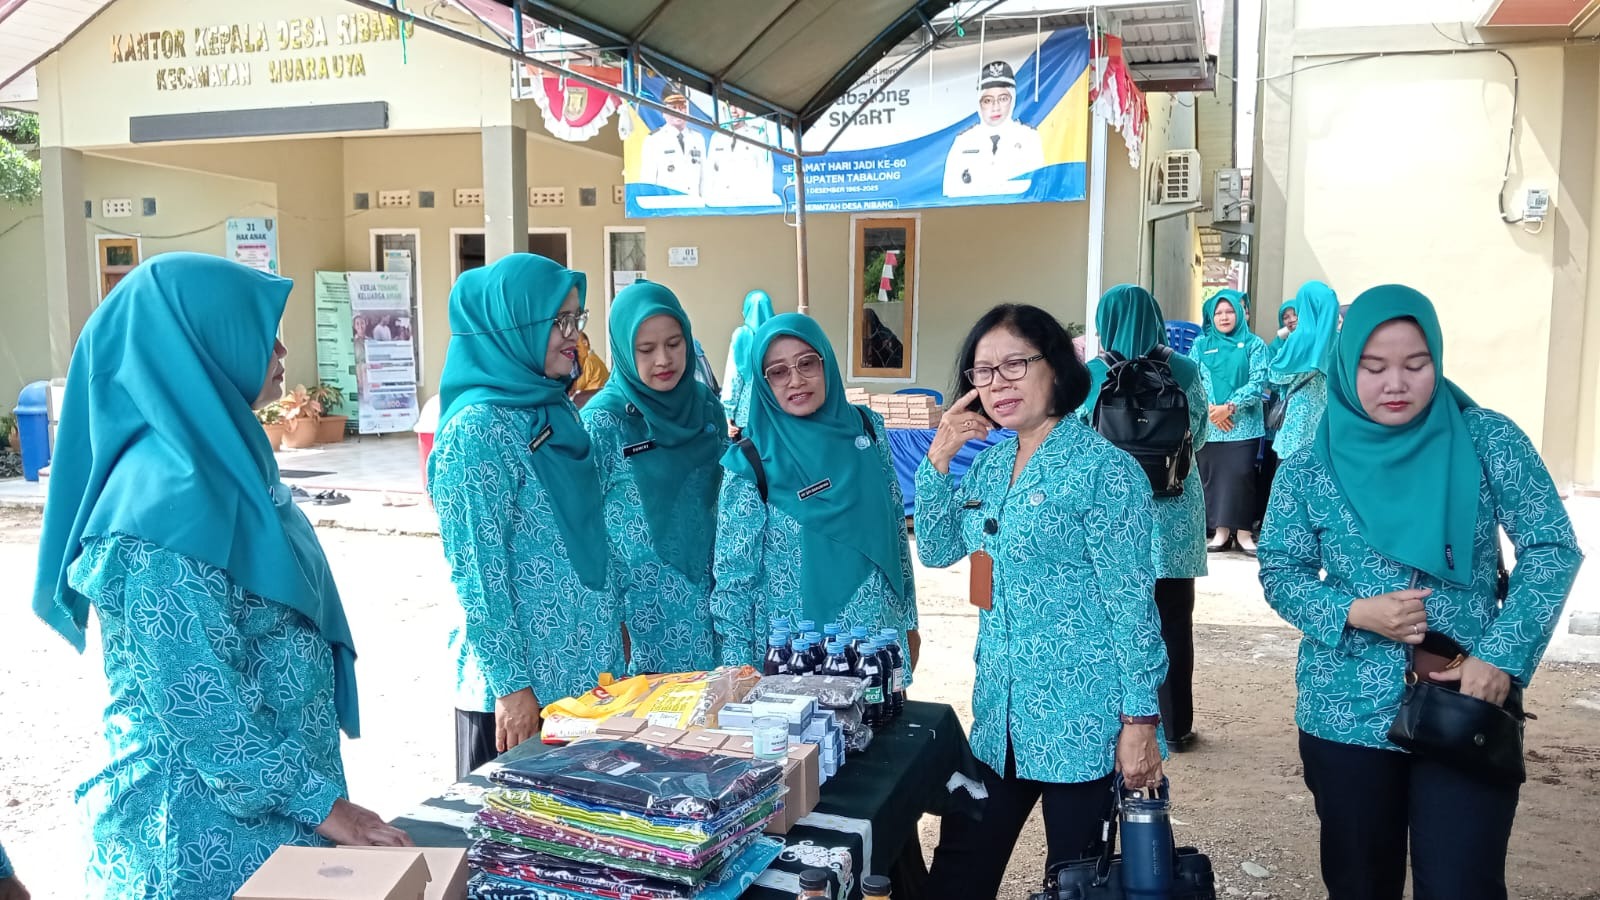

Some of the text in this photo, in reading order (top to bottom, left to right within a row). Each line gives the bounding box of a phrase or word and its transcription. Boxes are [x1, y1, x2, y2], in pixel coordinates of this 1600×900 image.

[112, 29, 186, 63] KANTOR
[195, 22, 269, 56] KEPALA
[277, 16, 328, 50] DESA
[157, 53, 366, 90] KECAMATAN MUARA UYA
[835, 88, 910, 106] abalong
[829, 107, 896, 127] SMaRT
[782, 159, 906, 174] SEMAT HARI JADI KE-60
[786, 171, 901, 185] KUPATEN TABALONG
[842, 202, 862, 210] DESA
[246, 223, 256, 231] 31
